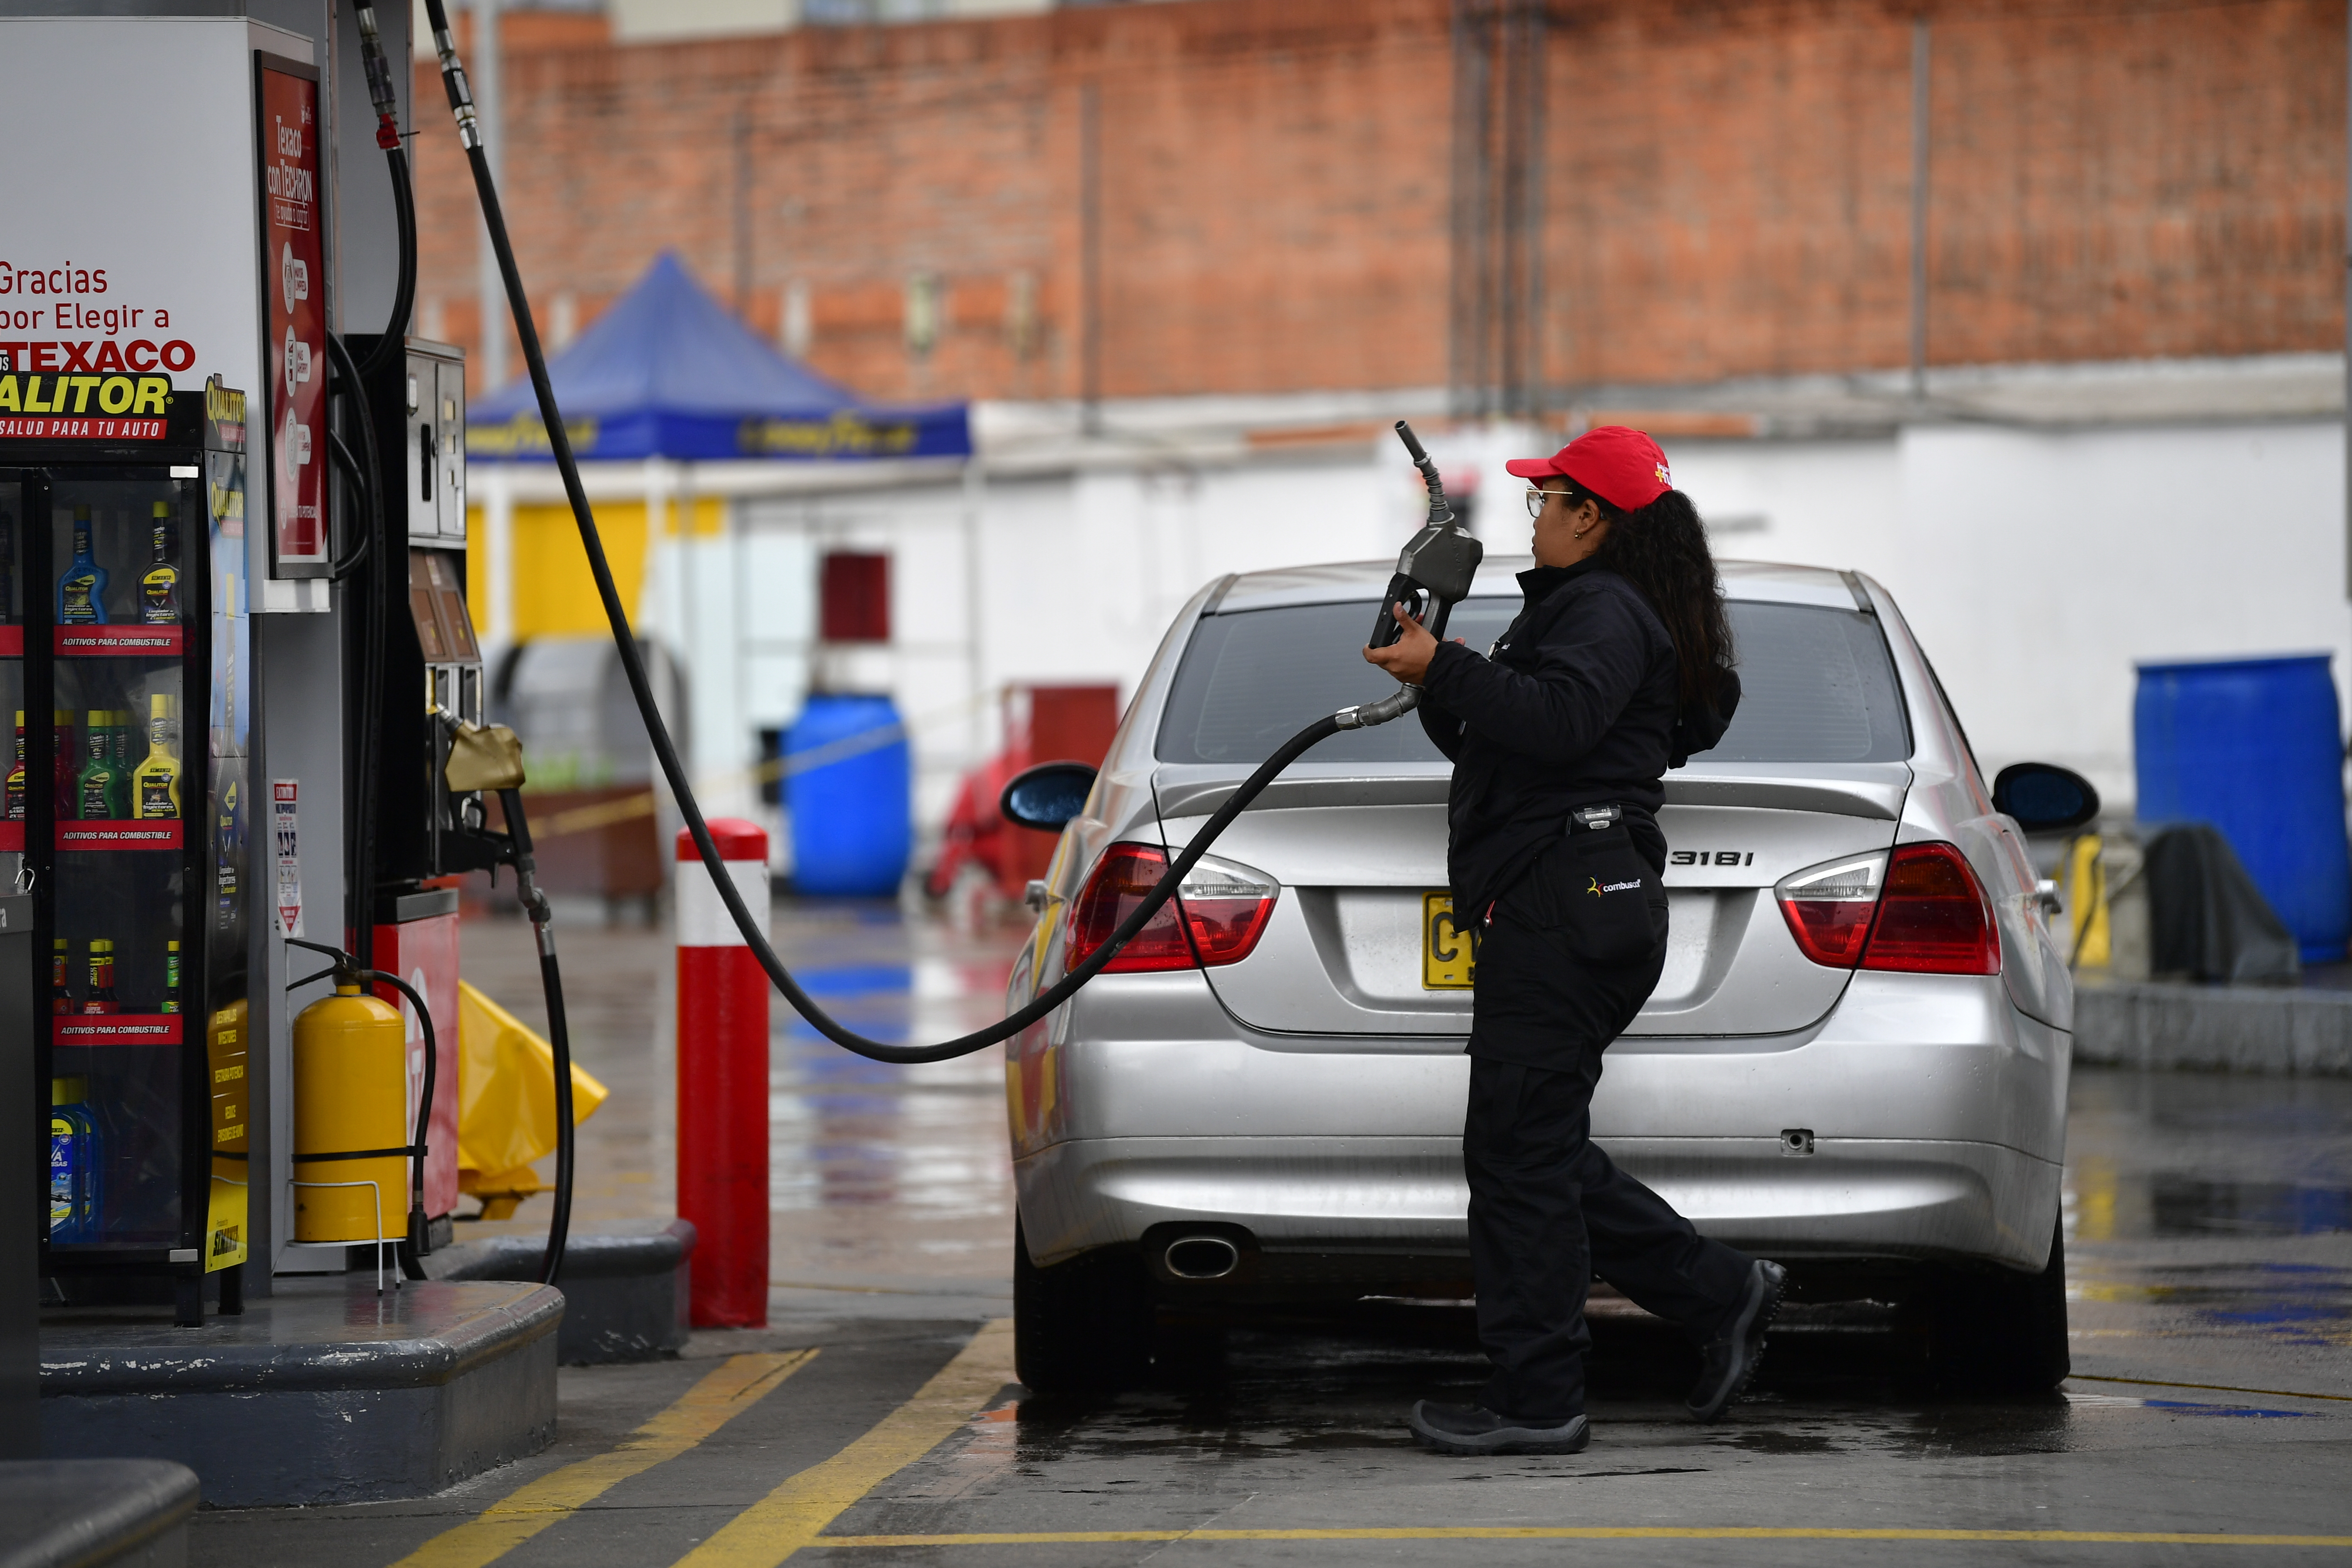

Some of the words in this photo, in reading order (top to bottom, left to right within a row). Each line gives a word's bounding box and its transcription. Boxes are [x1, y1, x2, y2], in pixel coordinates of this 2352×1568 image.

[276, 115, 302, 158] Texaco
[268, 165, 281, 195] con
[0, 261, 107, 294] Gracias
[56, 303, 144, 335] Elegir
[155, 309, 169, 328] a
[0, 339, 195, 372] TEXACO
[0, 357, 9, 371] S
[0, 420, 44, 435] SALUD
[52, 421, 89, 436] PARA
[98, 422, 114, 436] TU
[121, 422, 159, 436] AUTO
[118, 1026, 170, 1034] COMBUSTIBLE
